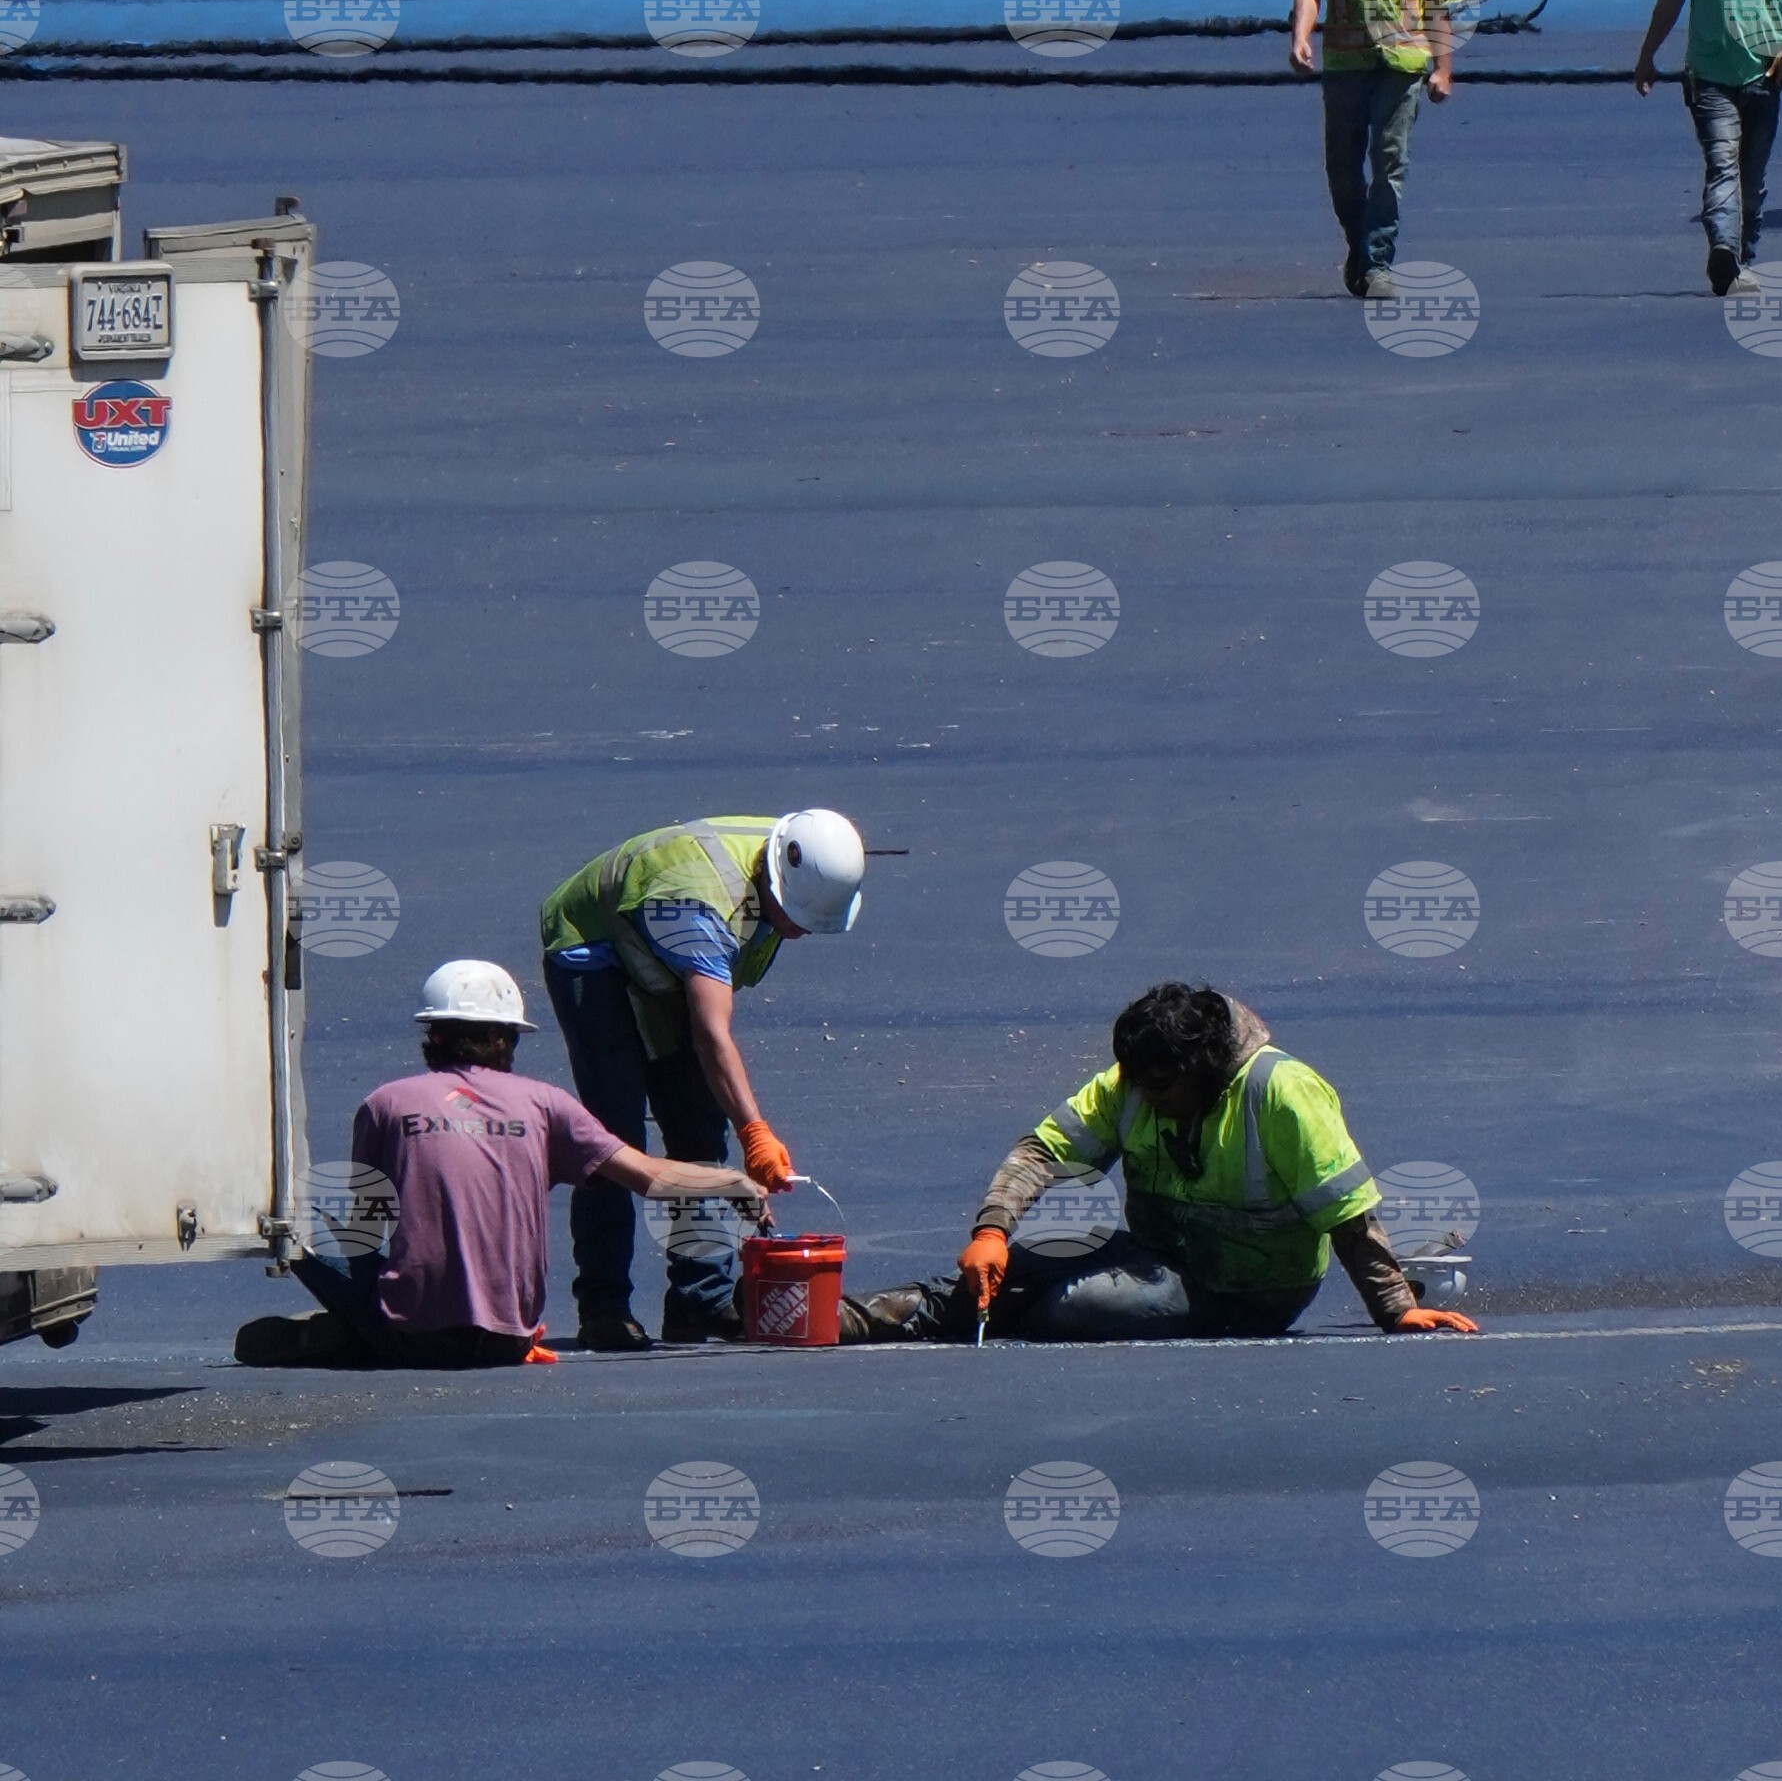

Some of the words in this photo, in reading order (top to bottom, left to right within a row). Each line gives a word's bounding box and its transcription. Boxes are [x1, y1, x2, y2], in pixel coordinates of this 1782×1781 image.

[73, 399, 172, 428] UXT
[107, 431, 160, 446] United
[758, 1284, 806, 1334] HOME
[762, 1287, 781, 1307] THE
[774, 1302, 808, 1335] DEPOT
